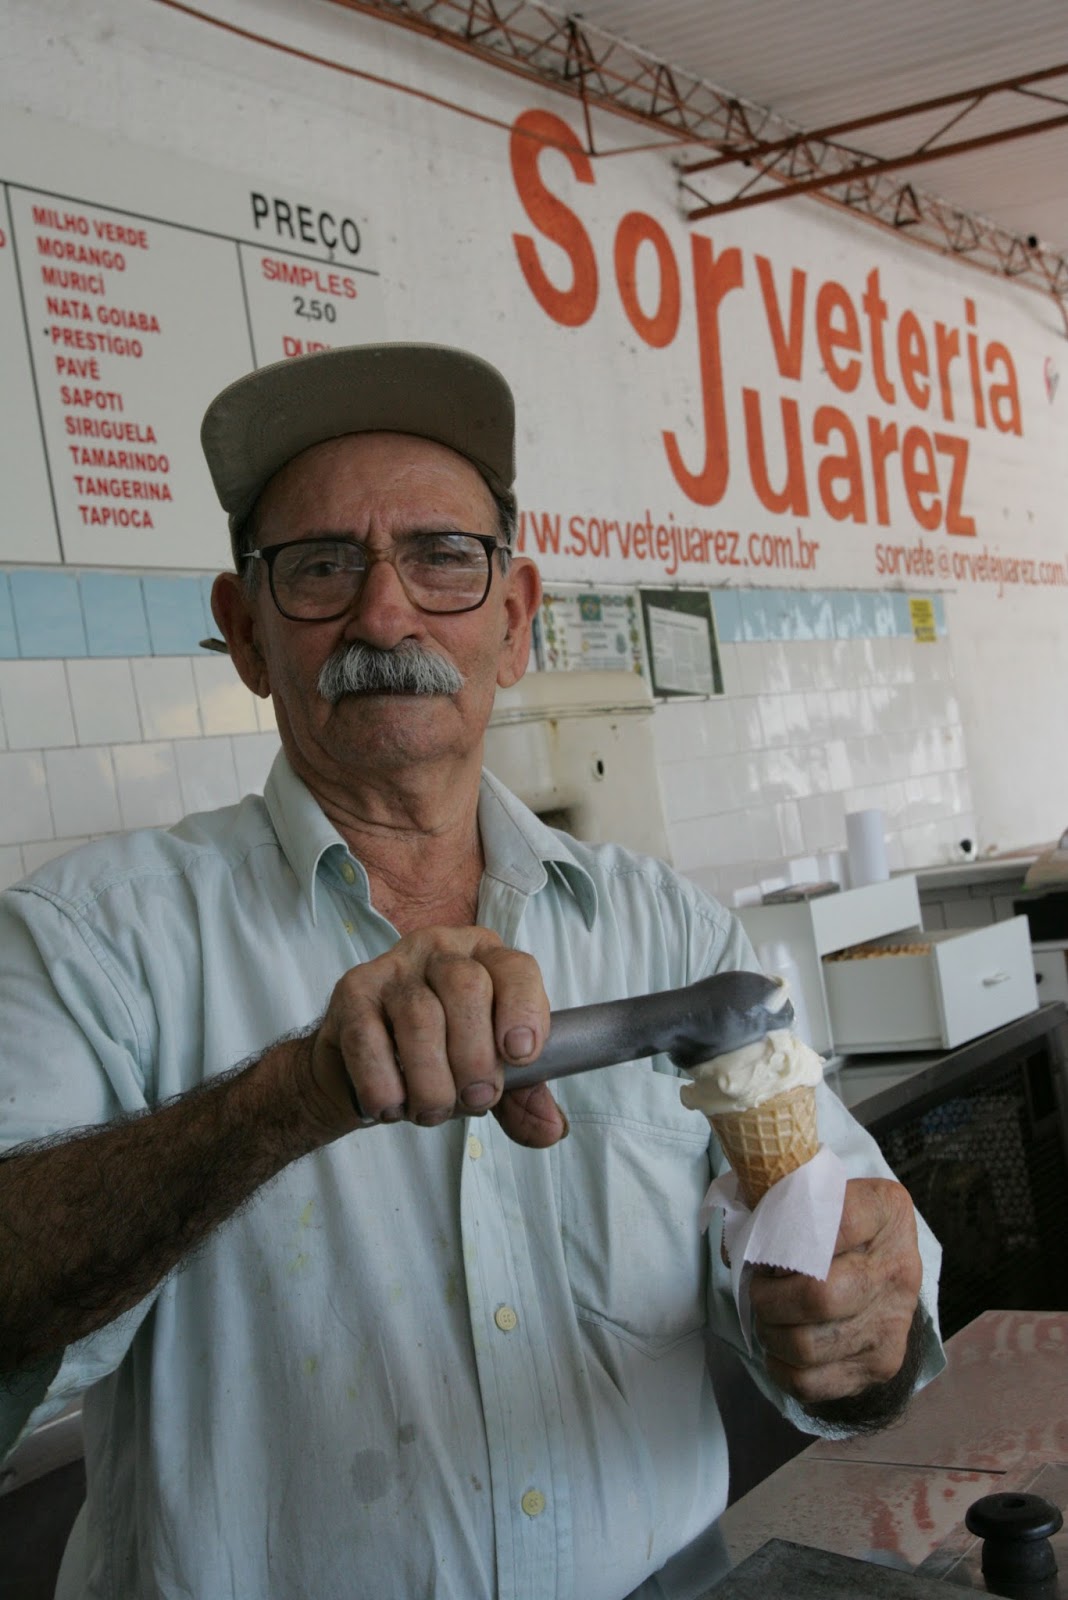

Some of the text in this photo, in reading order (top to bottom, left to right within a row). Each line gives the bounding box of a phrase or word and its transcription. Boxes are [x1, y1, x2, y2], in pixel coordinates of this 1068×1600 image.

[32, 205, 149, 250] MILHO VERDE
[251, 191, 361, 260] PREÇO
[36, 235, 126, 272] MORANGO
[260, 257, 358, 299] SIMPLES
[509, 108, 1023, 437] Sorveteria
[46, 295, 161, 333] NATA GOIABA
[60, 384, 124, 412] SAPOTI
[65, 415, 157, 444] SIRIGUELA
[661, 345, 977, 538] Juarez
[69, 445, 170, 474] TAMARINDO
[73, 474, 173, 501] TANGERINA
[79, 504, 154, 528] TAPIOCA
